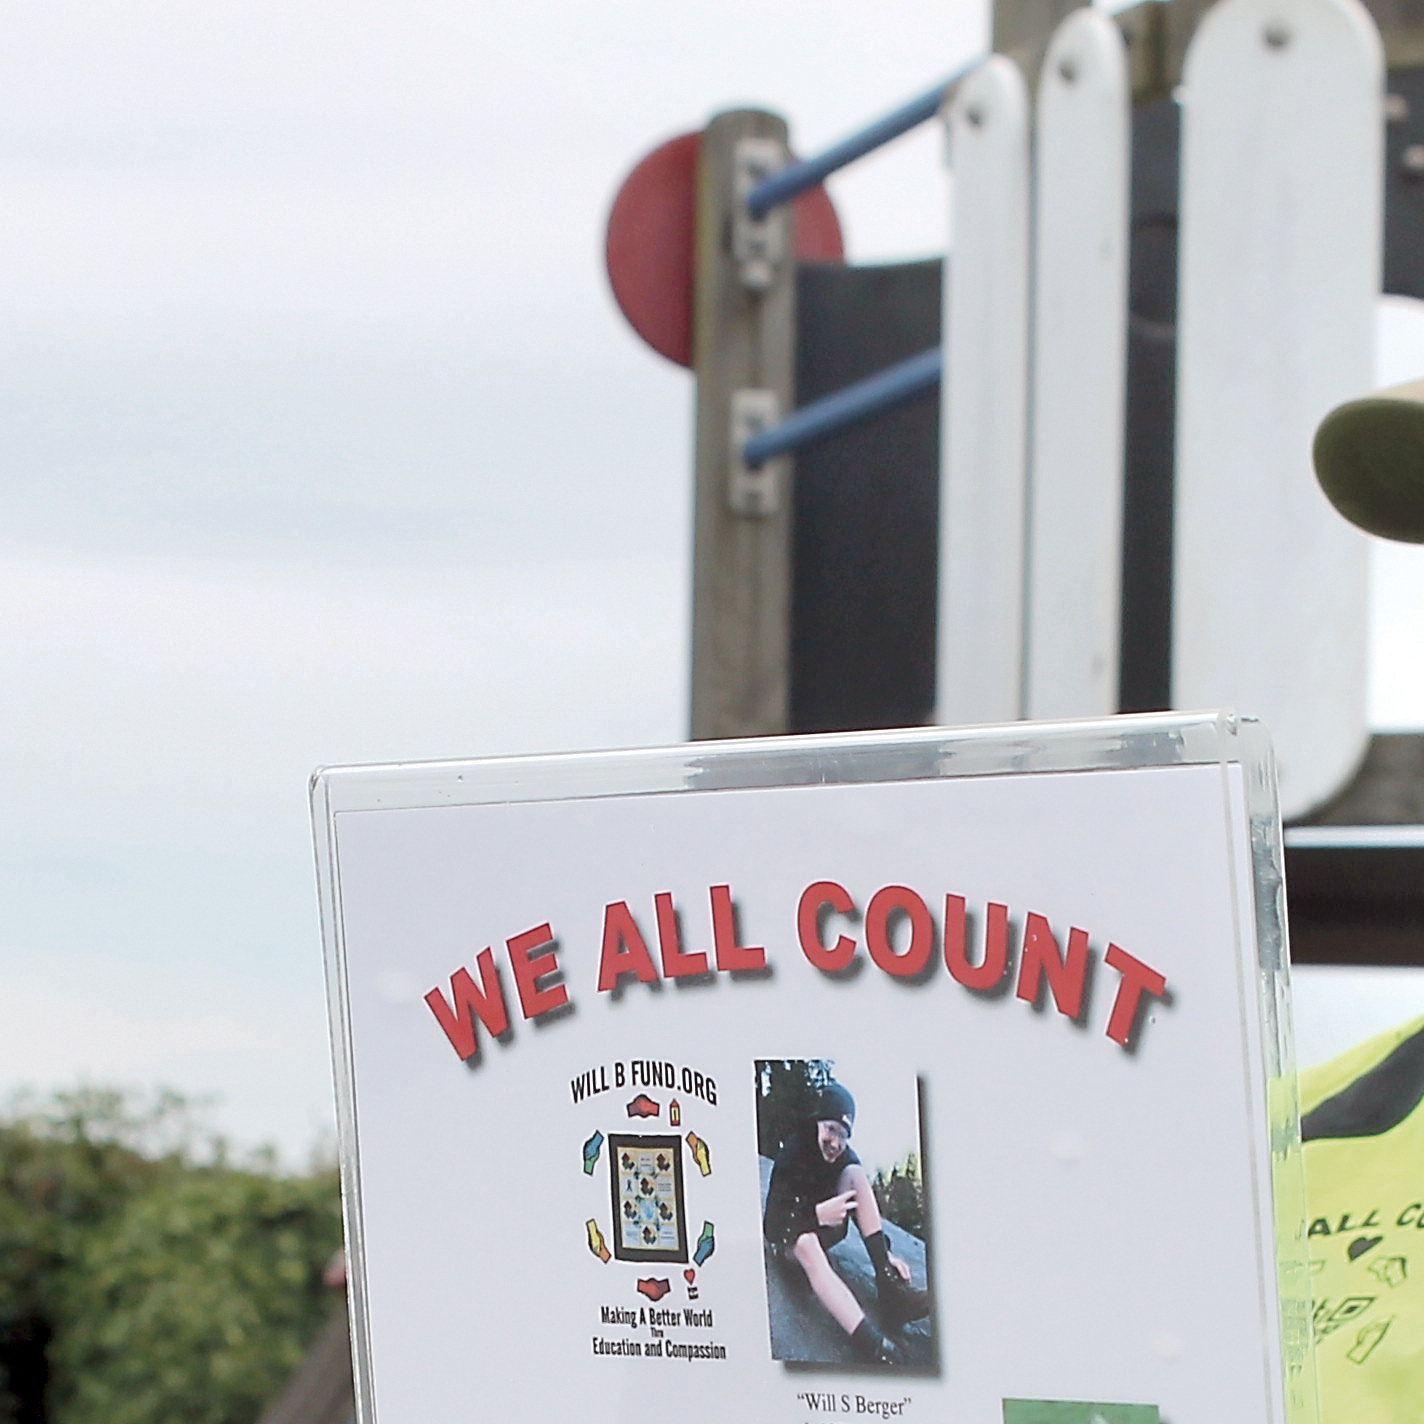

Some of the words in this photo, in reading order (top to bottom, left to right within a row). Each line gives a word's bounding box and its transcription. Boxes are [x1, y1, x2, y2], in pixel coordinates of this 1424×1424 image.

[423, 922, 571, 1062] WE
[597, 885, 766, 991] ALL
[797, 881, 1167, 1046] COUNT
[571, 1066, 610, 1104] WILL
[615, 1062, 625, 1088] B
[631, 1060, 717, 1106] FUND.ORG
[1307, 1209, 1380, 1239] ALL
[601, 1306, 637, 1328] Making
[640, 1308, 646, 1325] A
[649, 1308, 681, 1326] Better
[683, 1309, 713, 1327] World
[593, 1337, 641, 1356] Education
[645, 1340, 663, 1357] and
[665, 1340, 726, 1362] Compassion
[797, 1393, 836, 1412] “Will
[841, 1394, 851, 1413] S
[855, 1395, 912, 1419] Berger”
